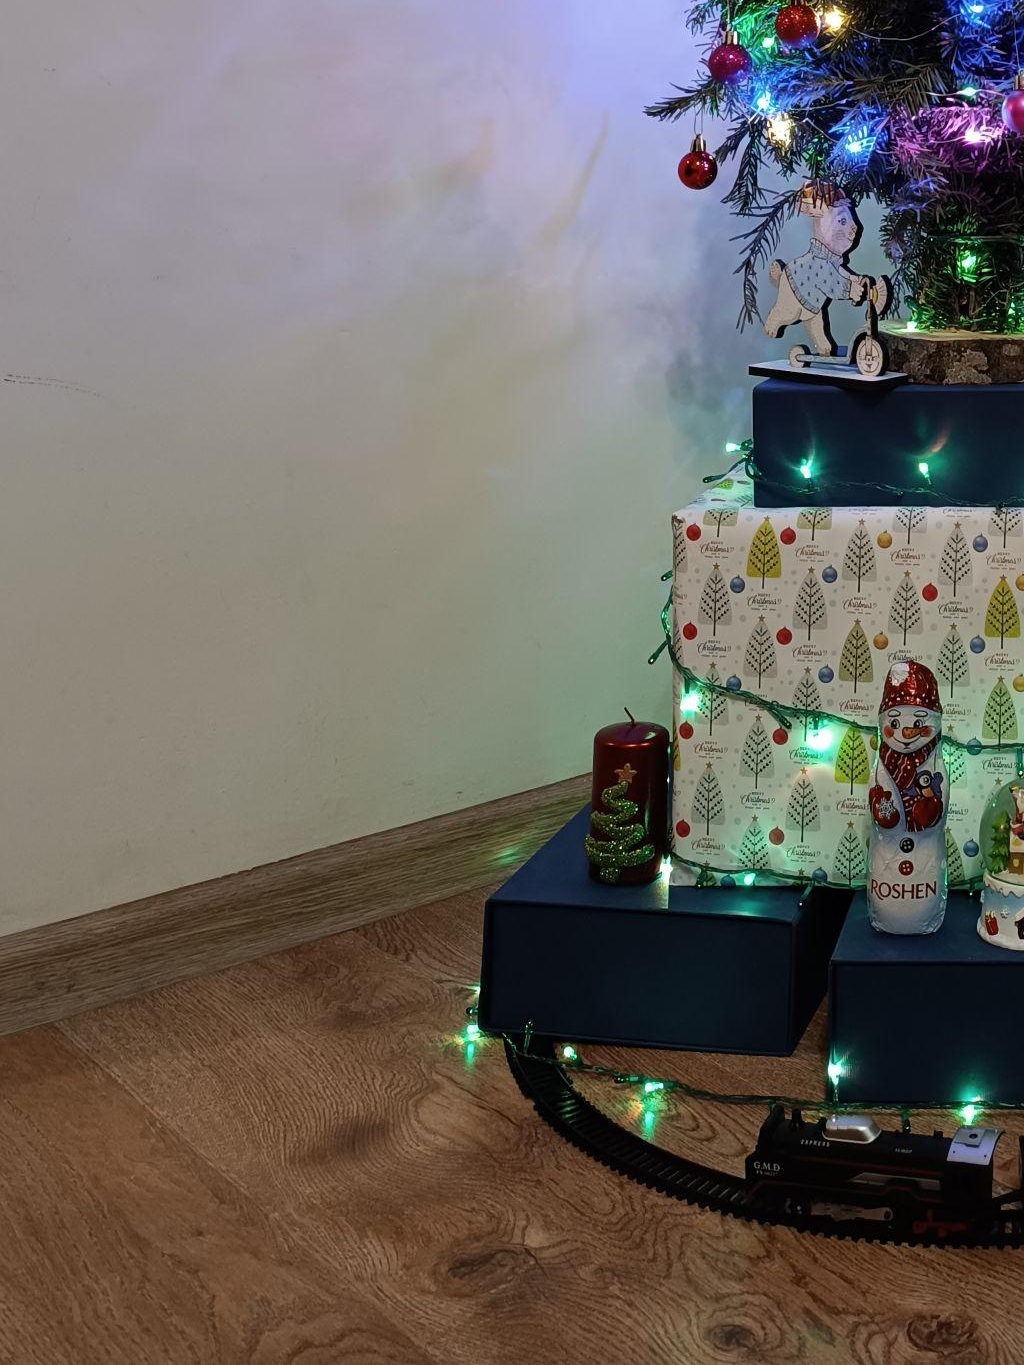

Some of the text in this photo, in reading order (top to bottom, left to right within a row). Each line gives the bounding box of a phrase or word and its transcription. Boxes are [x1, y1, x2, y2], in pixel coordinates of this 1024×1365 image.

[869, 877, 937, 900] ROSHEN
[800, 1138, 831, 1148] EXPRESS
[753, 1161, 781, 1172] G.M.D
